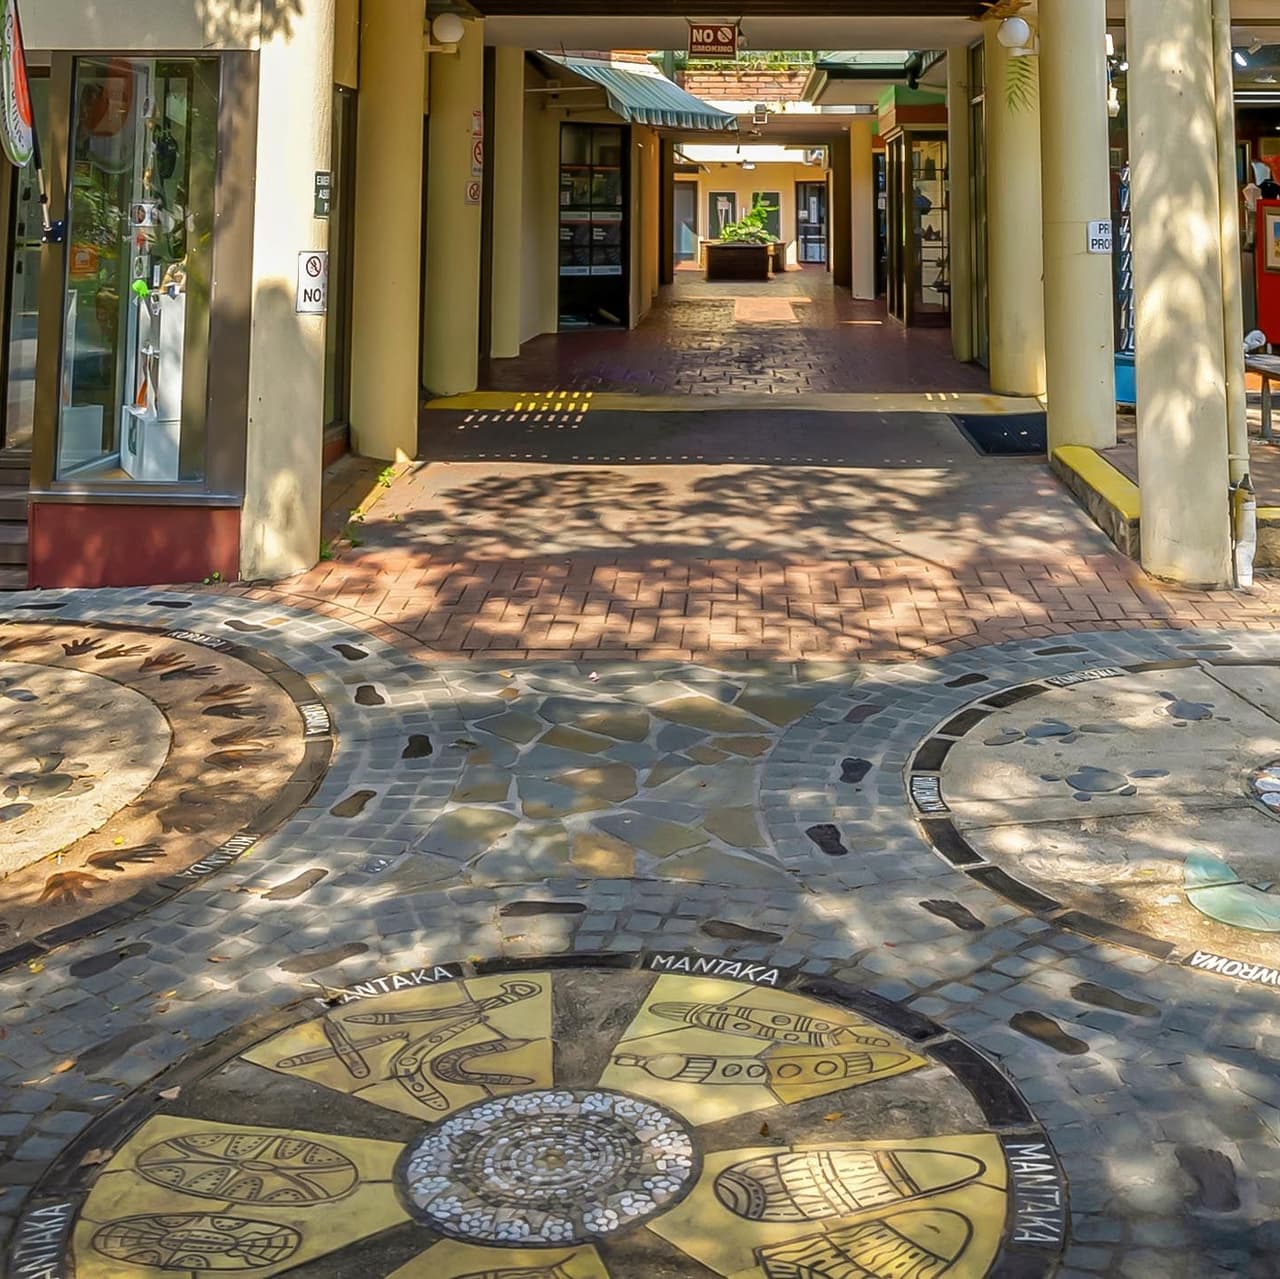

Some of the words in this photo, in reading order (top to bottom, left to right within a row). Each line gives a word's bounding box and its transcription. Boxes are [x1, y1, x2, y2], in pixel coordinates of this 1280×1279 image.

[692, 28, 714, 43] NO
[303, 288, 321, 302] NO
[651, 954, 780, 985] MANTAKA
[1005, 1143, 1062, 1242] MANTAKA
